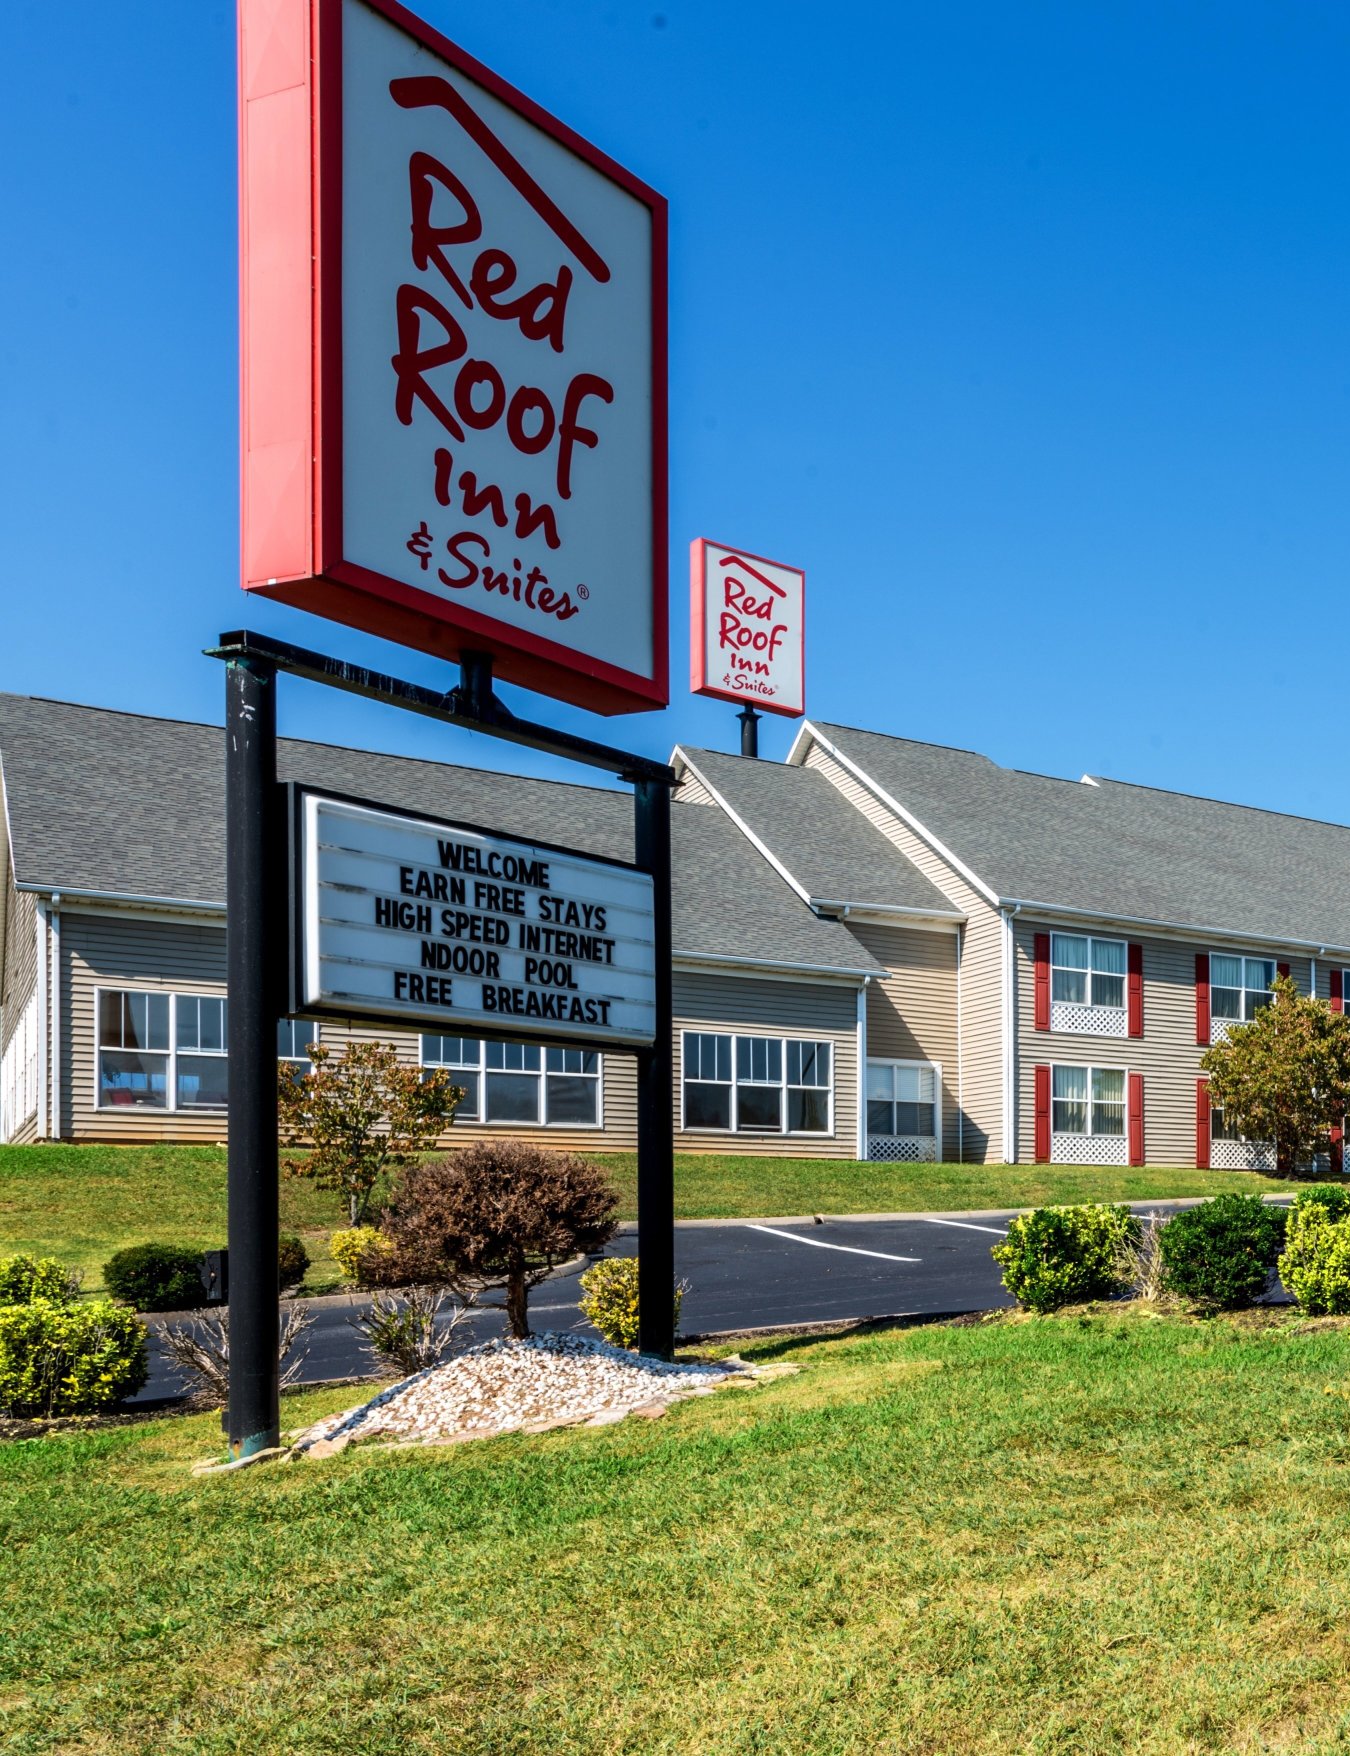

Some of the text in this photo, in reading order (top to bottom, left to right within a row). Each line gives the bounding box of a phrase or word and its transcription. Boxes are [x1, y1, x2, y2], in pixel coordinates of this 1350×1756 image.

[409, 151, 573, 354] Red
[391, 283, 614, 500] Roof
[434, 447, 561, 550] Inn
[406, 521, 434, 571] &
[724, 576, 774, 620] Red
[719, 611, 787, 661] Roof
[723, 673, 730, 686] &
[730, 653, 769, 676] Inn
[437, 839, 550, 889] WELCOME
[400, 865, 607, 931] EARN FREE STAYS
[375, 896, 616, 965] HIGH SPEED INTERNET
[421, 940, 579, 990] NDOOR POOL
[394, 970, 612, 1026] FREE BREAKFAST
